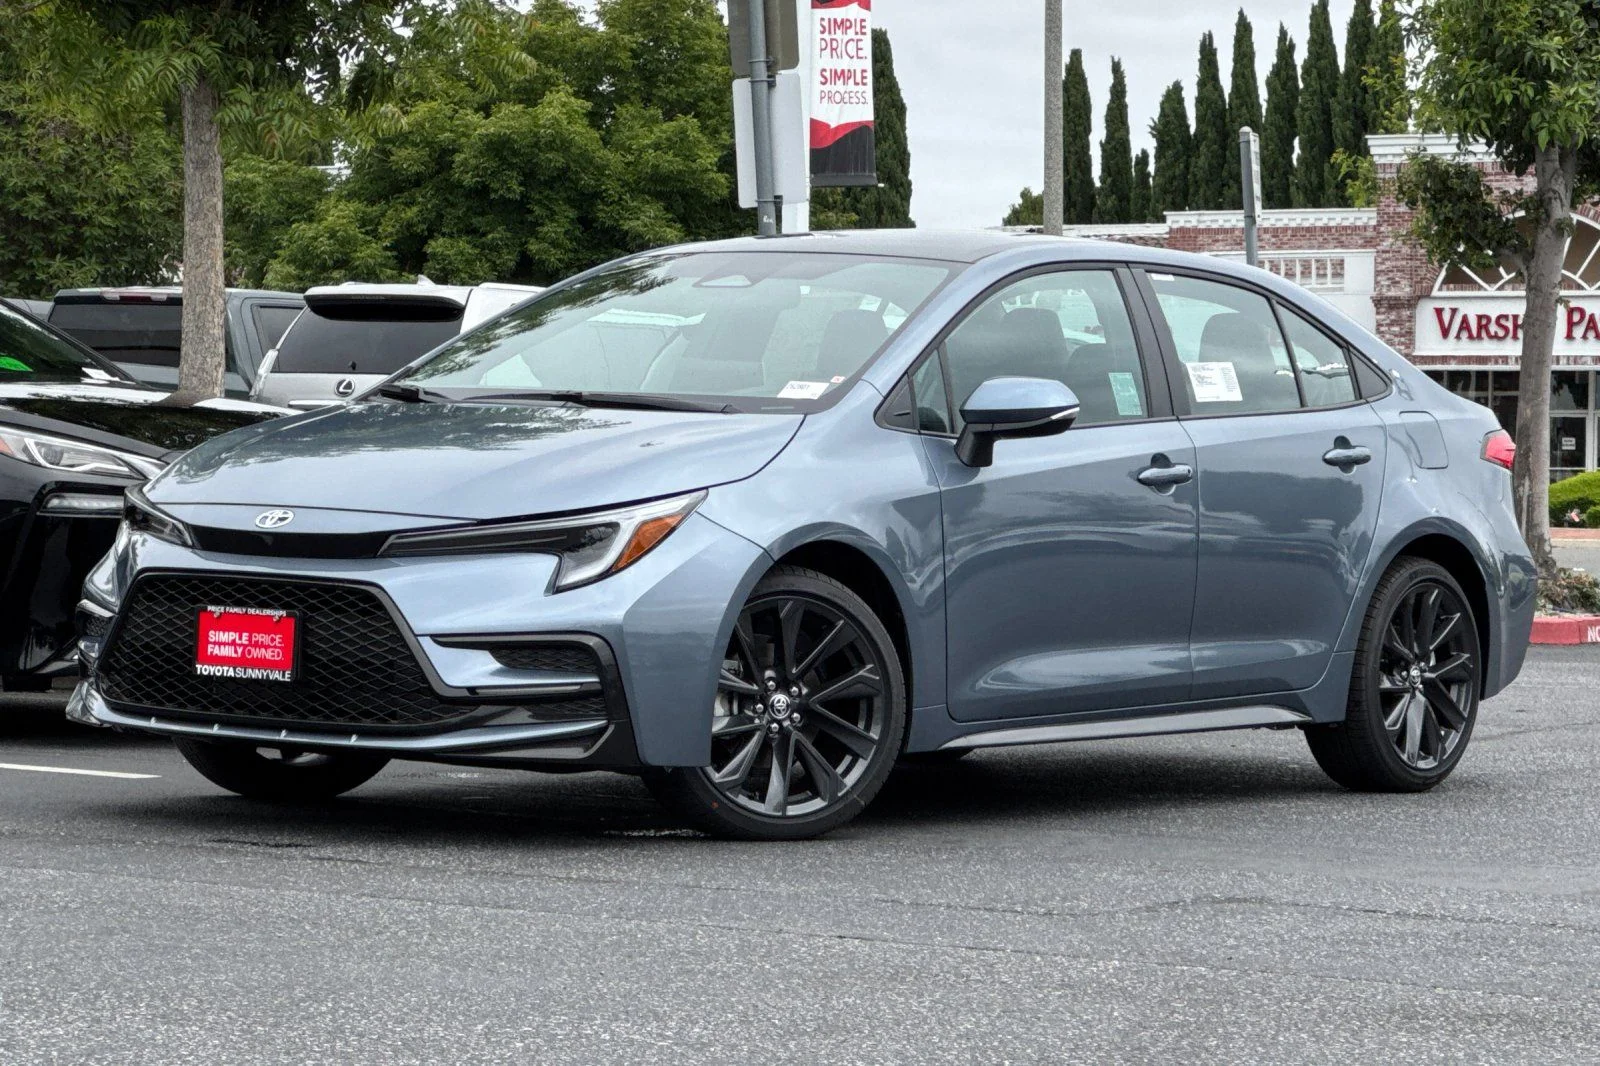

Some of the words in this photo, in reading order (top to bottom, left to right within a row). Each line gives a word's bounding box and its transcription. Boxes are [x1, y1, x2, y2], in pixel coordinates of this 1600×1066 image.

[819, 17, 867, 36] SIMPLE
[819, 38, 868, 60] PRICE.
[819, 68, 868, 87] SIMPLE
[819, 90, 869, 105] PROCESS.
[207, 605, 225, 613] PRICE
[225, 606, 247, 615] FAMILY
[247, 607, 287, 617] DEALERSHIPS
[208, 630, 249, 644] SIMPLE
[251, 632, 285, 647] PRICE.
[207, 644, 243, 658] FAMILY
[245, 646, 285, 661] OWNED.
[196, 664, 235, 678] TOYOTA
[234, 667, 291, 682] SUNNYVALE
